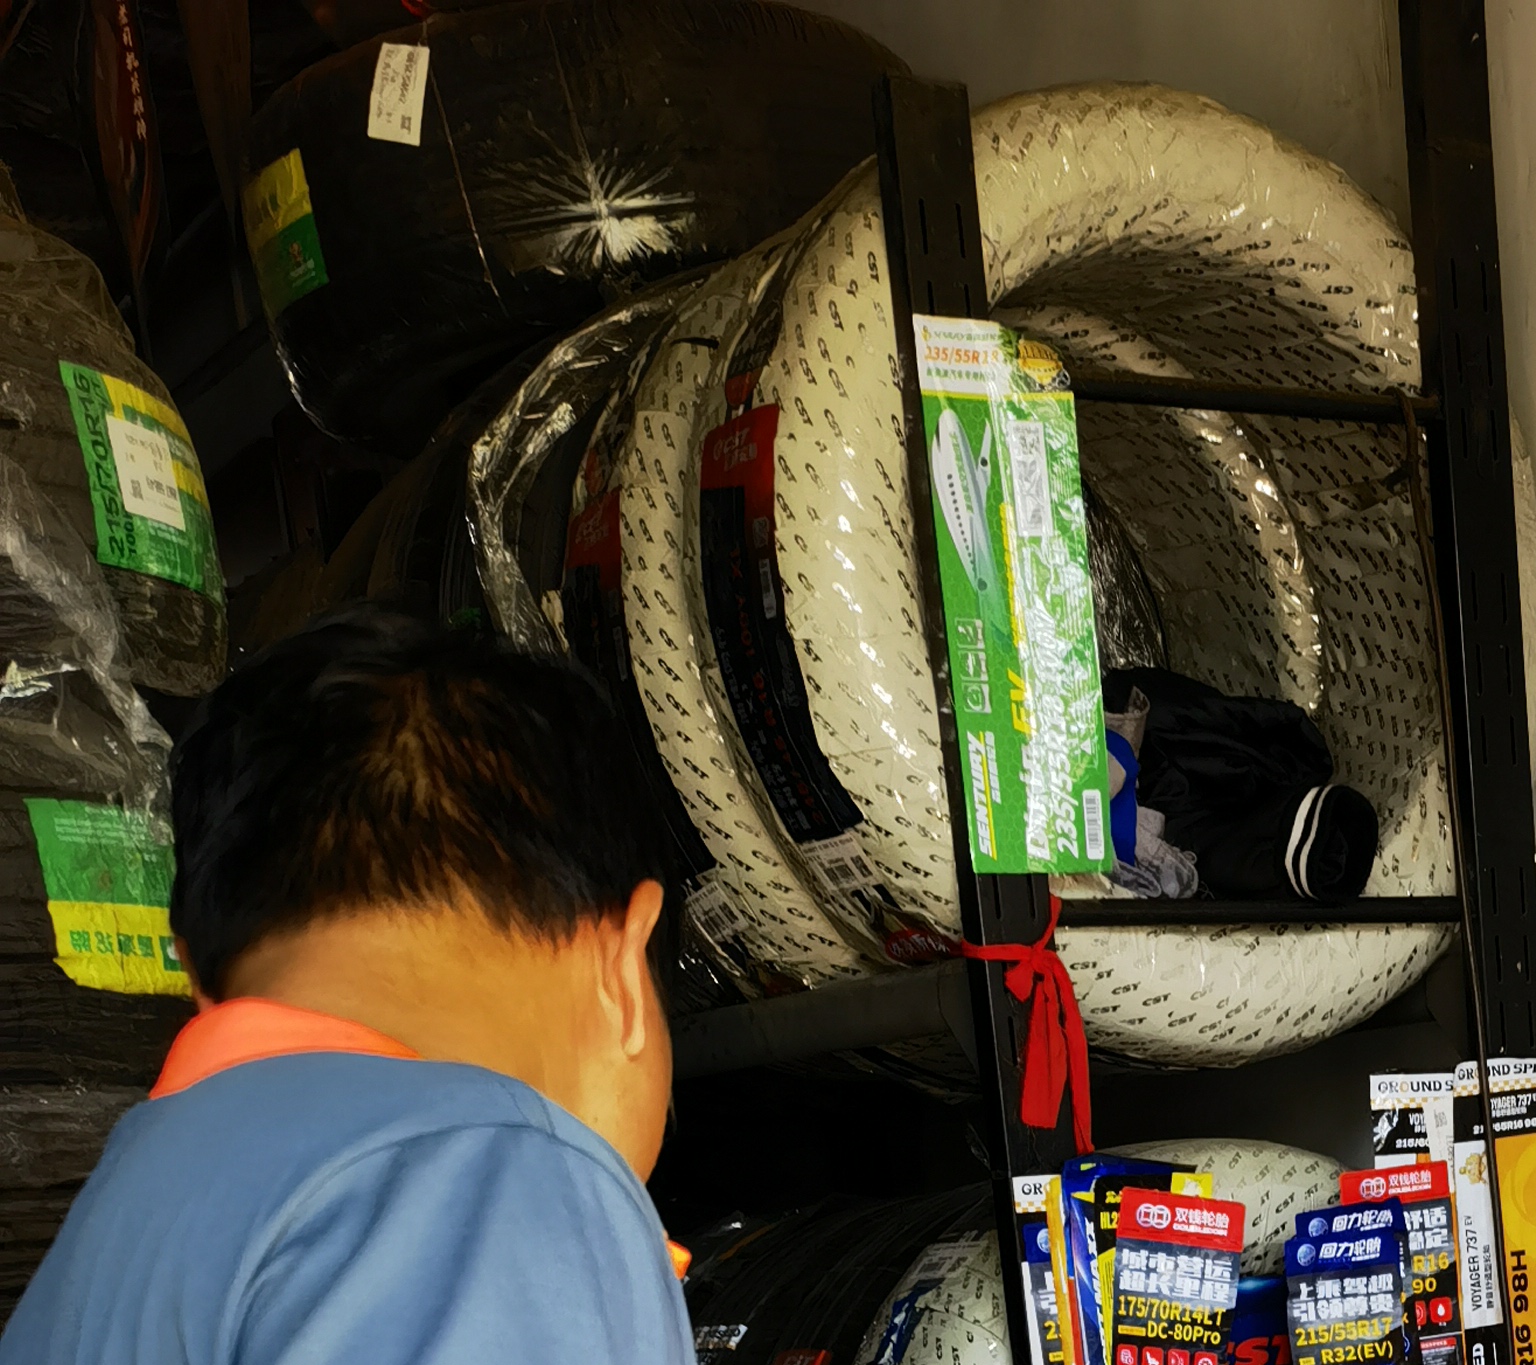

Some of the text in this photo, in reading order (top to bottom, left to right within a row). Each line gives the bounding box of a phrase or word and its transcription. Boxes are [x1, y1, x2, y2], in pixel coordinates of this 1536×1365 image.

[867, 251, 880, 284] CST
[828, 300, 844, 331] CST
[799, 357, 818, 386] CST
[828, 368, 849, 400] CST
[888, 353, 902, 392] CST
[794, 397, 813, 427] CST
[824, 408, 843, 438] CST
[661, 423, 676, 450] CST
[654, 458, 669, 486] CST
[777, 454, 797, 483] CST
[776, 493, 796, 521] CST
[632, 585, 651, 610] CST
[654, 589, 678, 616] CST
[635, 619, 654, 646] CST
[658, 627, 679, 651] CST
[657, 657, 684, 683] CST
[967, 730, 994, 860] SENTURY
[1070, 960, 1098, 971] CST
[1111, 981, 1141, 996] CST
[1142, 992, 1171, 1007] CST
[1167, 1012, 1197, 1028] CST
[1225, 999, 1250, 1019] CST
[1457, 1063, 1511, 1081] GRUND
[1228, 1151, 1242, 1170] CST
[1282, 1165, 1298, 1183] CST
[1304, 1160, 1321, 1174] CST
[1275, 1192, 1295, 1214] CST
[1174, 1207, 1230, 1229] 双钱轮胎
[1319, 1235, 1382, 1259] 回力轮胎
[1465, 1228, 1478, 1252] 737
[1121, 1248, 1233, 1282] 城市营运
[975, 1278, 984, 1300] CST
[1119, 1270, 1231, 1304] 超长里程
[1292, 1272, 1395, 1303] 上乘驾趣
[1470, 1253, 1483, 1312] VOYAGER
[1511, 1249, 1530, 1314] 98H
[1118, 1295, 1227, 1327] 175/70R14LT
[1292, 1292, 1395, 1323] 引领尊贵
[1146, 1320, 1222, 1345] DC-80Pro
[1295, 1317, 1394, 1347] 215/55R17
[1320, 1340, 1394, 1365] R32(EV)
